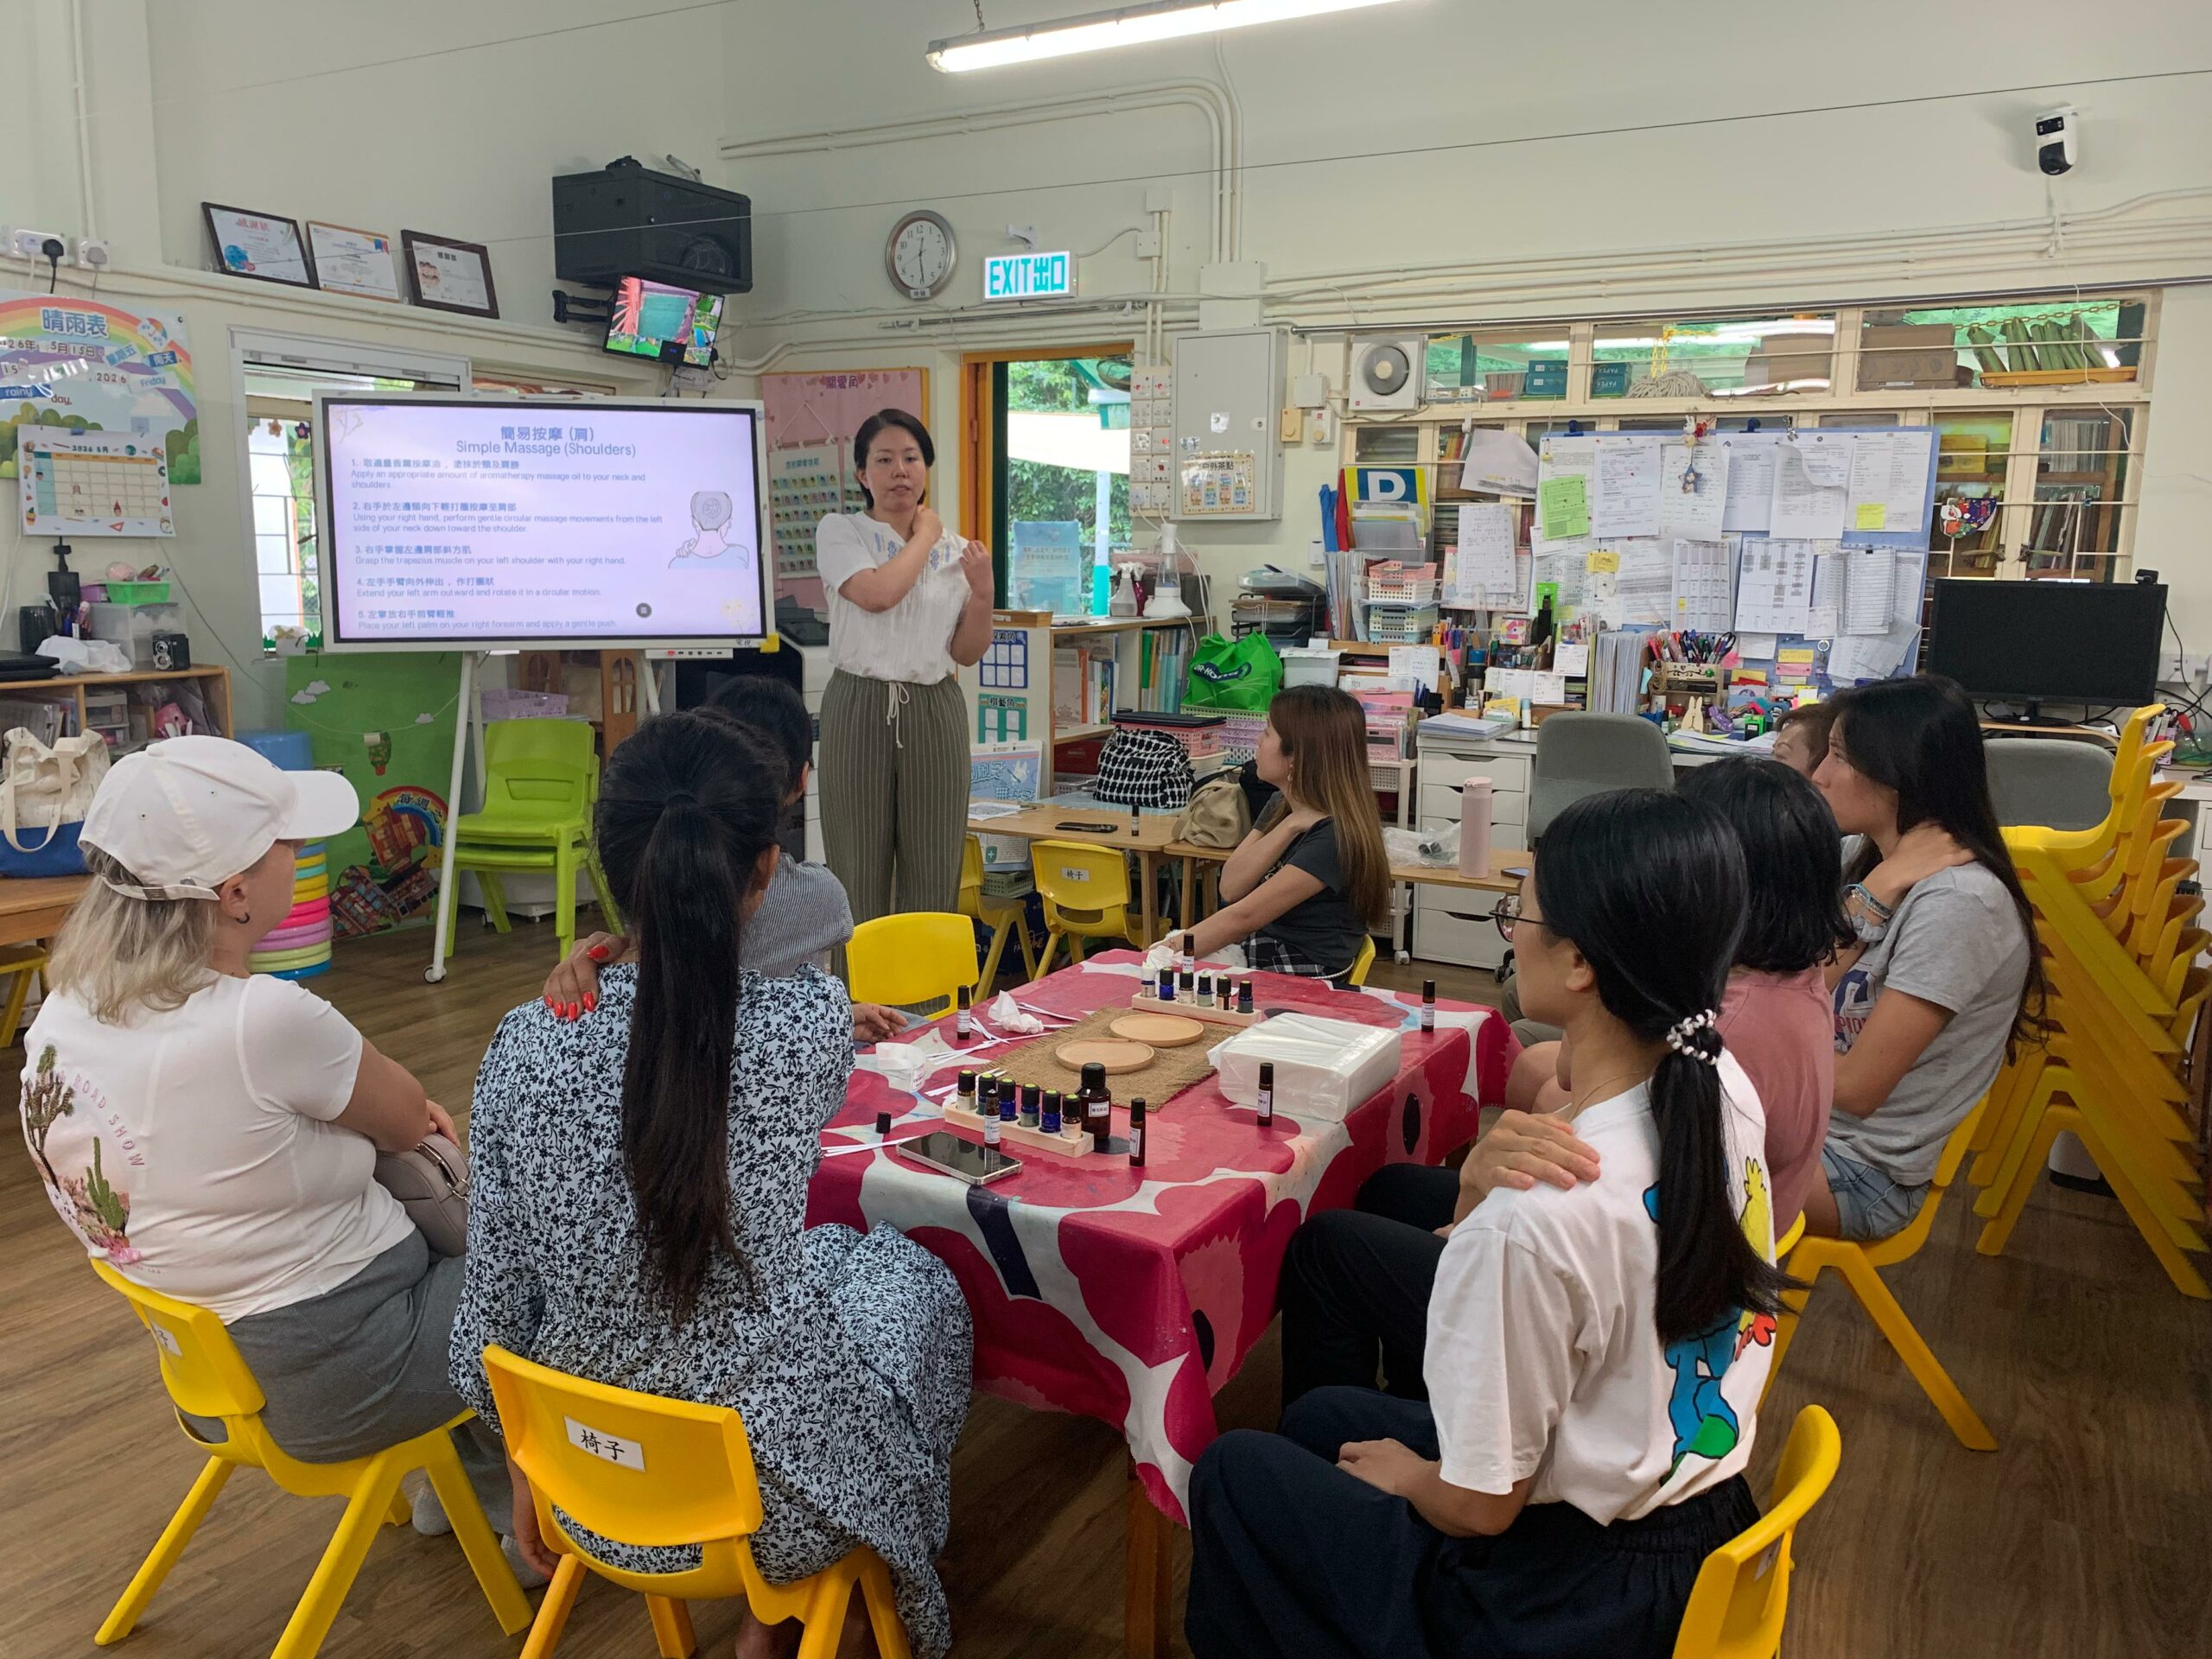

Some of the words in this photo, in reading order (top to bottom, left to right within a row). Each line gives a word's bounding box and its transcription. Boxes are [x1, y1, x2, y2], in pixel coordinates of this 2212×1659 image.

[907, 230, 913, 238] 11
[916, 225, 924, 234] 12
[929, 226, 932, 235] 1
[937, 235, 941, 244] 2
[899, 241, 907, 250] 10
[940, 247, 945, 256] 3
[938, 261, 942, 270] 4
[901, 267, 906, 276] 8
[930, 272, 935, 281] 5
[989, 258, 1033, 296] EXIT
[1033, 255, 1065, 292] 出口
[910, 275, 914, 283] 7
[920, 276, 925, 284] 6
[41, 308, 108, 337] 晴雨表
[140, 376, 167, 387] Friday
[5, 386, 33, 397] rainy
[51, 395, 73, 405] day.
[456, 440, 500, 454] Simple
[505, 442, 561, 457] Massage
[564, 442, 637, 458] (Shoulders)
[352, 470, 374, 479] Apply
[389, 471, 435, 480] appropriate
[480, 471, 535, 481] aromatherapy
[1367, 471, 1406, 502] P
[353, 514, 376, 523] Using
[443, 514, 475, 523] perform
[478, 514, 502, 523] gentle
[504, 514, 531, 523] circular
[616, 515, 634, 524] from
[650, 515, 663, 524] left
[355, 556, 380, 565] Grasp
[397, 556, 433, 565] trapezius
[585, 557, 603, 566] right
[357, 588, 385, 597] Extend
[359, 621, 380, 630] Place
[417, 621, 439, 630] palm
[472, 620, 490, 630] right
[542, 620, 563, 629] apply
[1066, 869, 1084, 880] 椅子
[73, 1073, 106, 1109] ROAD
[109, 1114, 144, 1166] SHOW
[580, 1429, 626, 1461] 椅子
